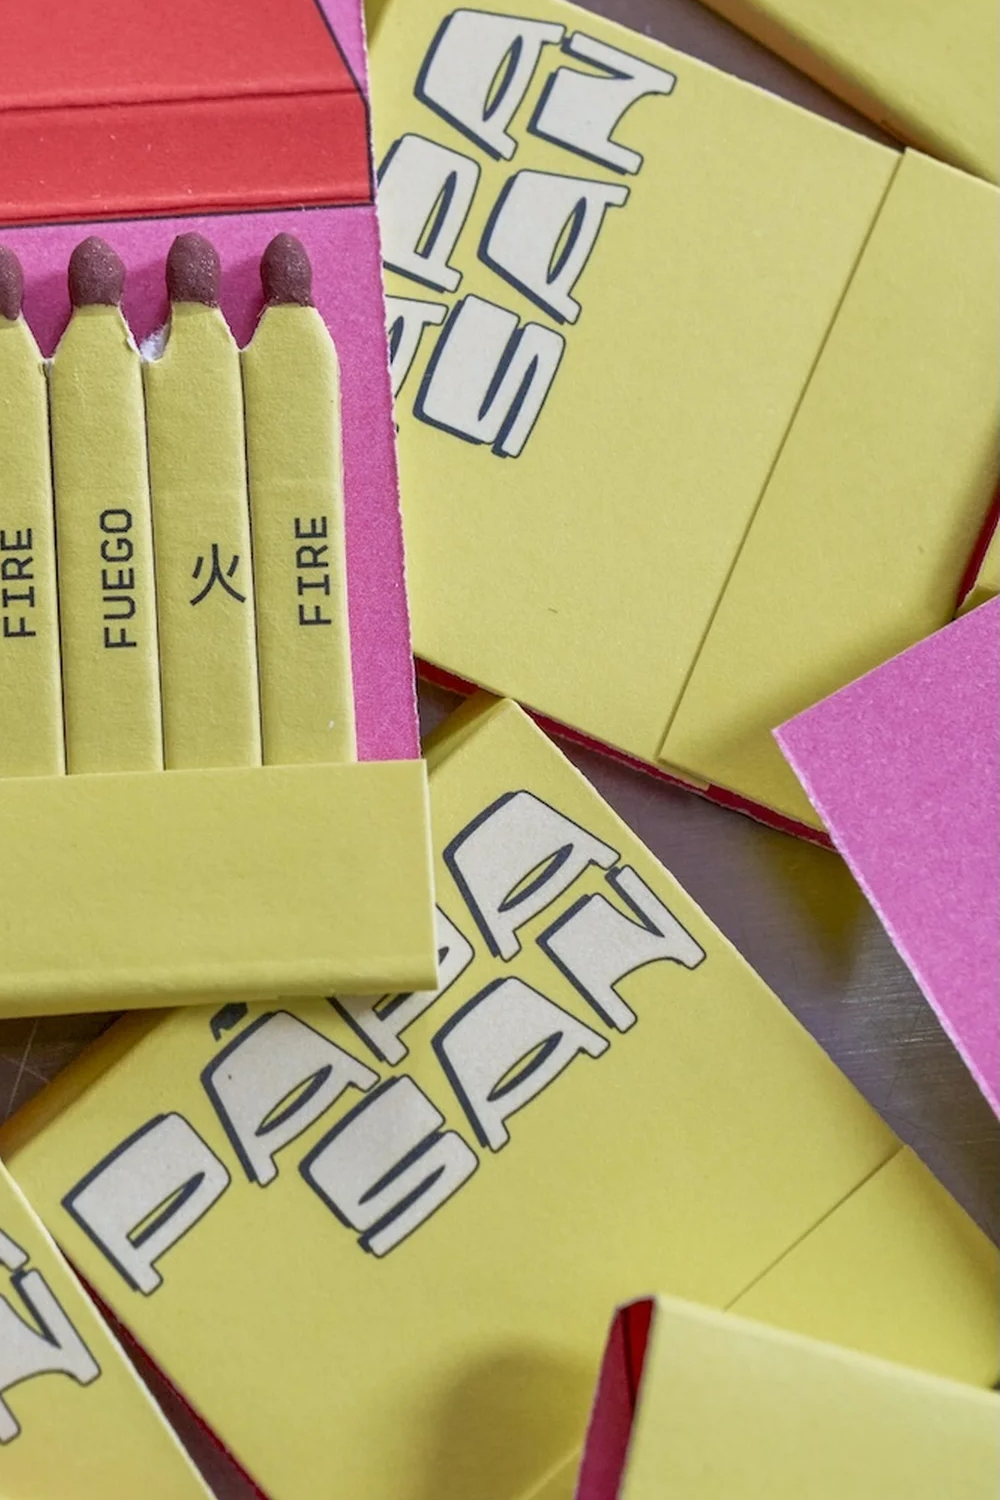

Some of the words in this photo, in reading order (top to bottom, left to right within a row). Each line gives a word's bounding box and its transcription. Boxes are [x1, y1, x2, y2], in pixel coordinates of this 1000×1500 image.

[413, 31, 677, 460] SAN
[0, 528, 36, 638] FIRE
[100, 508, 137, 649] FUEGO
[190, 544, 247, 606] 火
[294, 516, 333, 626] FIRE
[299, 865, 706, 1257] SAN
